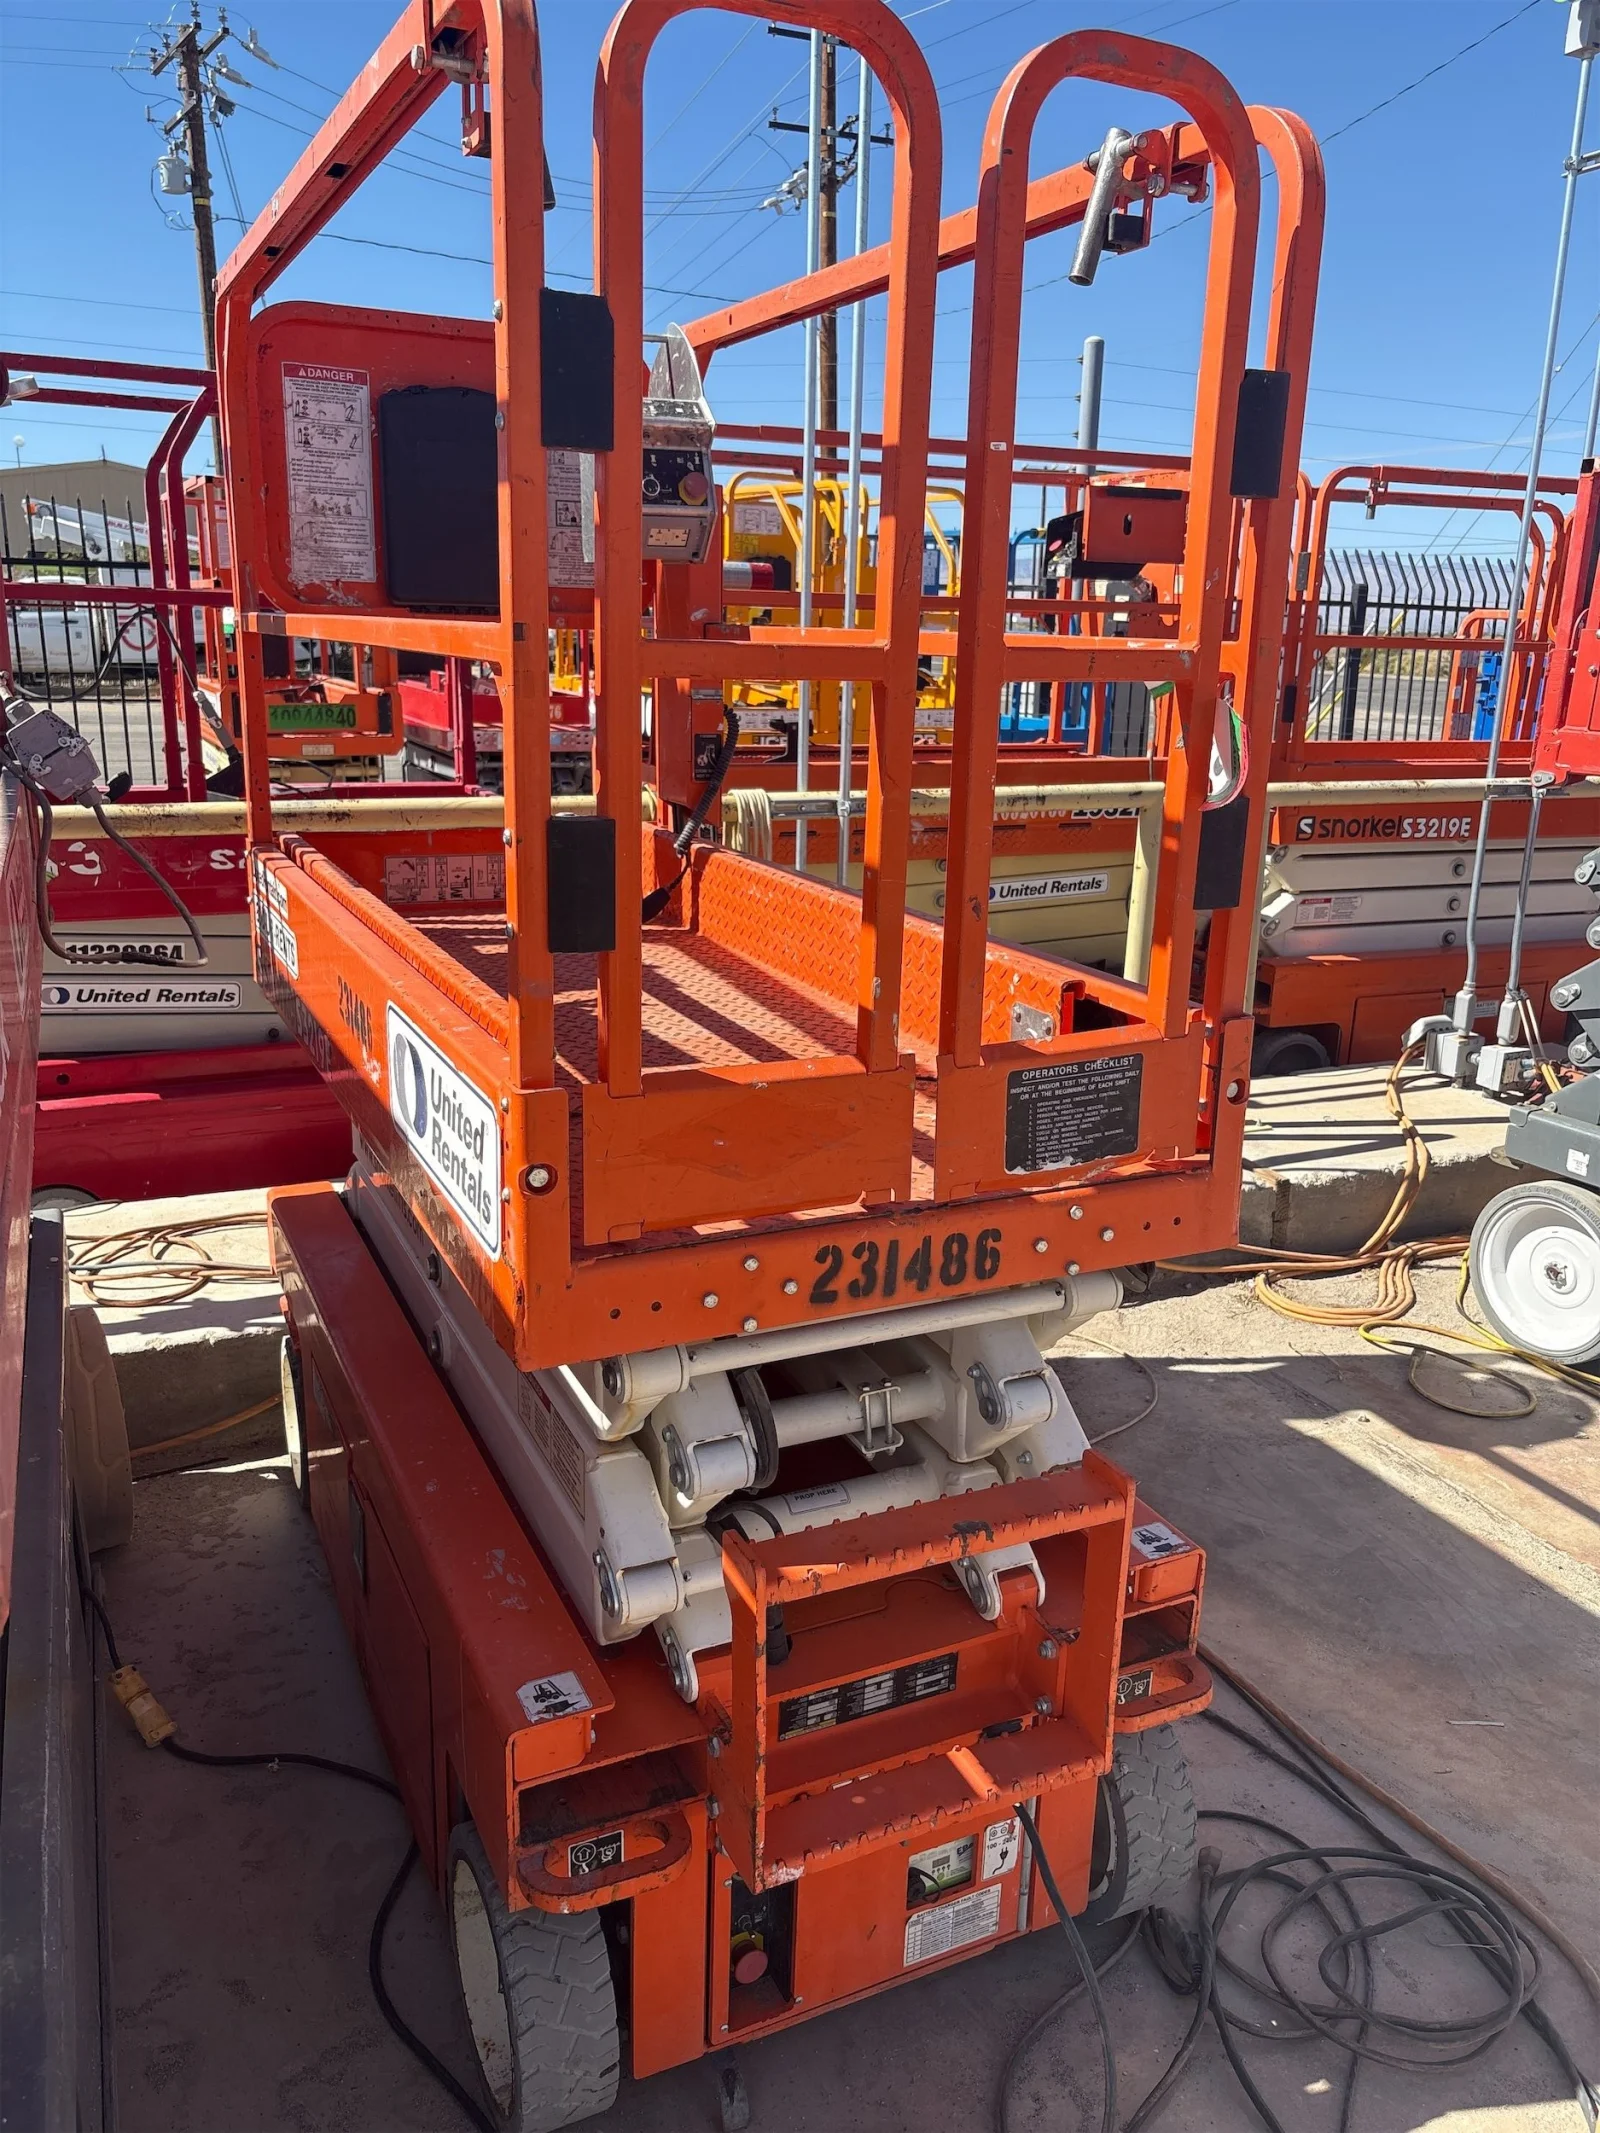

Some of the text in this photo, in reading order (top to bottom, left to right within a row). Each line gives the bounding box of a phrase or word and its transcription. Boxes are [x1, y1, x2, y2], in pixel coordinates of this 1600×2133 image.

[307, 367, 354, 382] DANGER
[1318, 815, 1402, 839] snorkel
[1401, 817, 1472, 839] S3219E
[999, 877, 1102, 900] United Rentals
[75, 987, 237, 1004] United Rentals
[1022, 1056, 1135, 1081] OPERATORS CHECKLIST
[1010, 1070, 1140, 1094] INSPECT AND/OR TEST THE FOLLOWING DAILY
[1020, 1093, 1030, 1101] OR
[1041, 1090, 1053, 1098] THE
[1055, 1085, 1086, 1096] BEGINNING
[1088, 1083, 1097, 1091] OF
[1098, 1080, 1113, 1089] EACH
[1115, 1078, 1130, 1087] SHIFT
[430, 1067, 486, 1164] United
[432, 1115, 492, 1226] Rentals
[809, 1227, 1003, 1305] 231486
[794, 1487, 838, 1501] PROP HERE
[916, 1907, 937, 1918] BATTERY
[937, 1900, 960, 1912] CHARGER
[960, 1894, 975, 1904] FAULT
